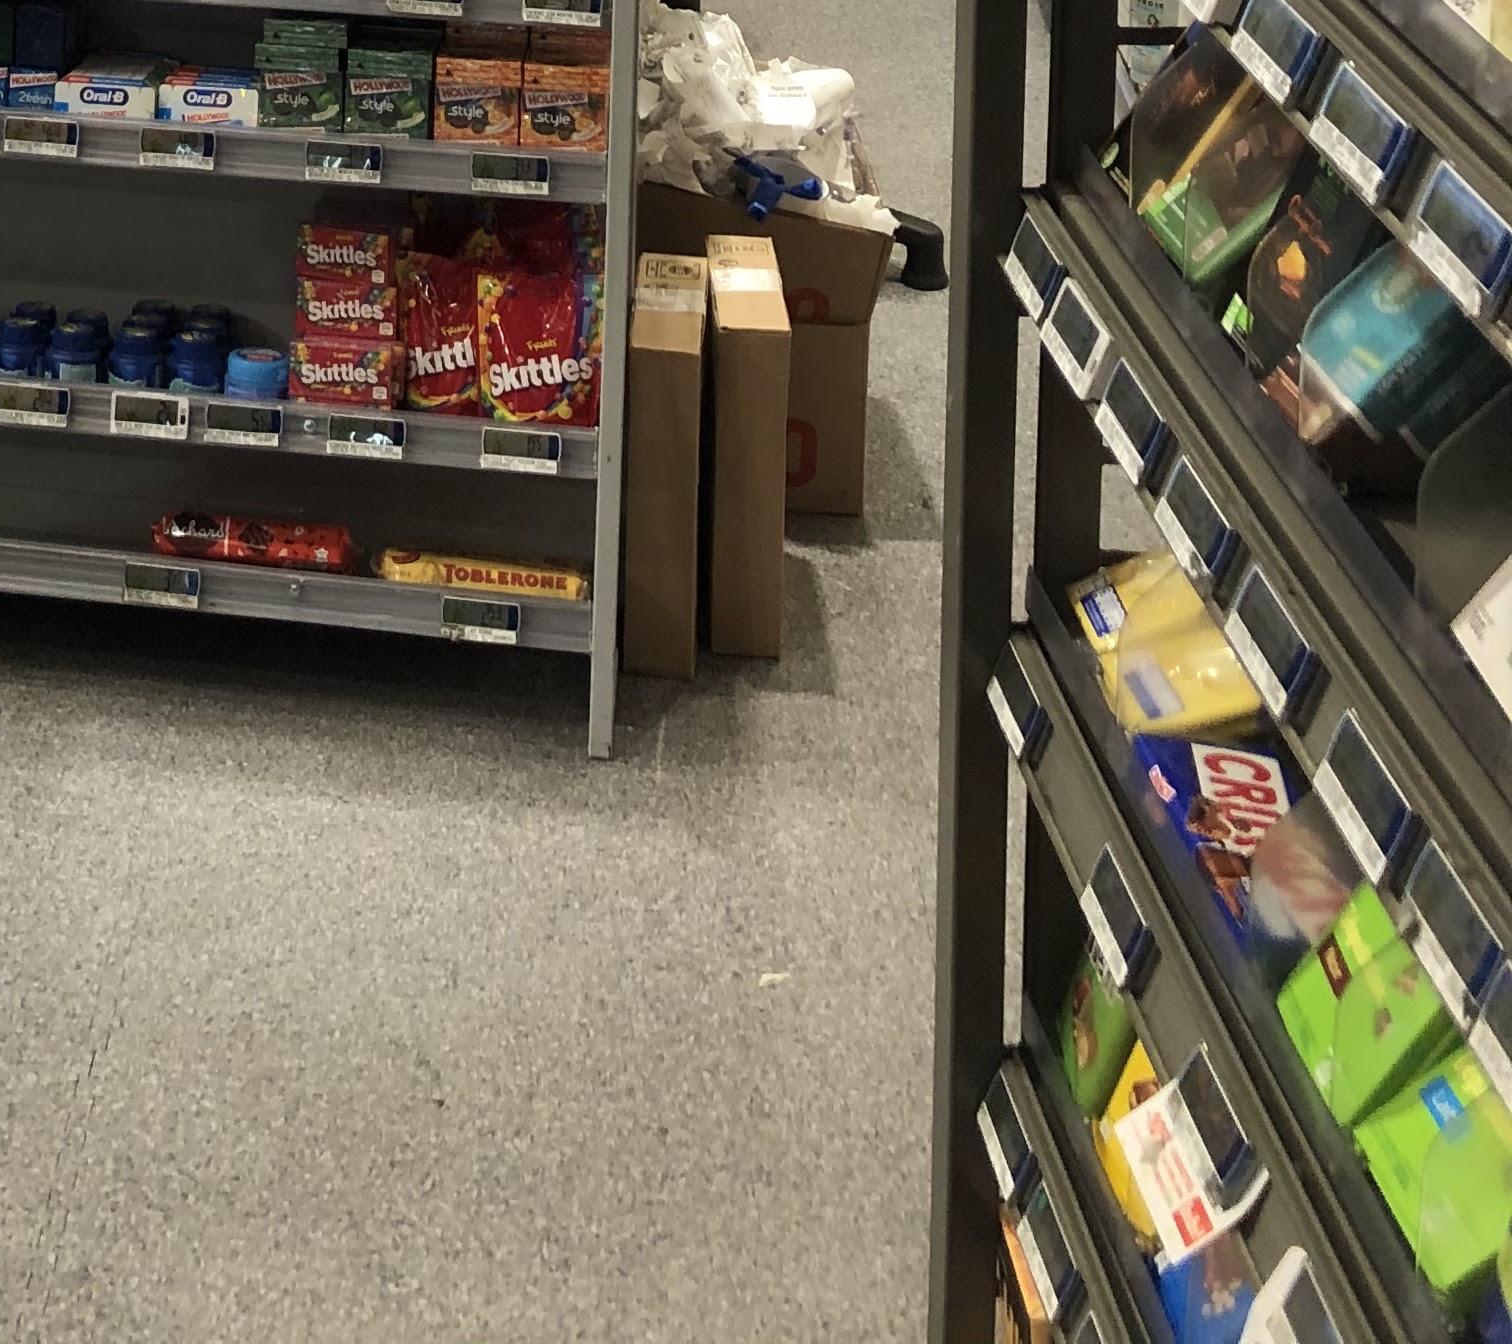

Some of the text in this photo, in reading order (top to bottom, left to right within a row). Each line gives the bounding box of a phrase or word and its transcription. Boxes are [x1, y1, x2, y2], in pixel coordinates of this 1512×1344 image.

[12, 73, 57, 86] HOLLYWOOD
[266, 73, 323, 88] HOLLYWOOD
[352, 78, 411, 93] HOLLYWOOD
[18, 90, 53, 105] 2fresh
[82, 88, 127, 103] Oral-B
[186, 90, 229, 106] Oral-B
[274, 89, 309, 106] style
[441, 85, 499, 99] HOLLYWOOD
[528, 92, 585, 106] HOLLYWOOD
[359, 98, 394, 114] style
[448, 104, 484, 120] style
[537, 110, 571, 127] style
[306, 243, 377, 267] Skittles
[308, 299, 384, 321] Skittles
[301, 362, 378, 384] Skittles
[490, 354, 593, 396] Skittles
[444, 564, 568, 590] TOBLERONE
